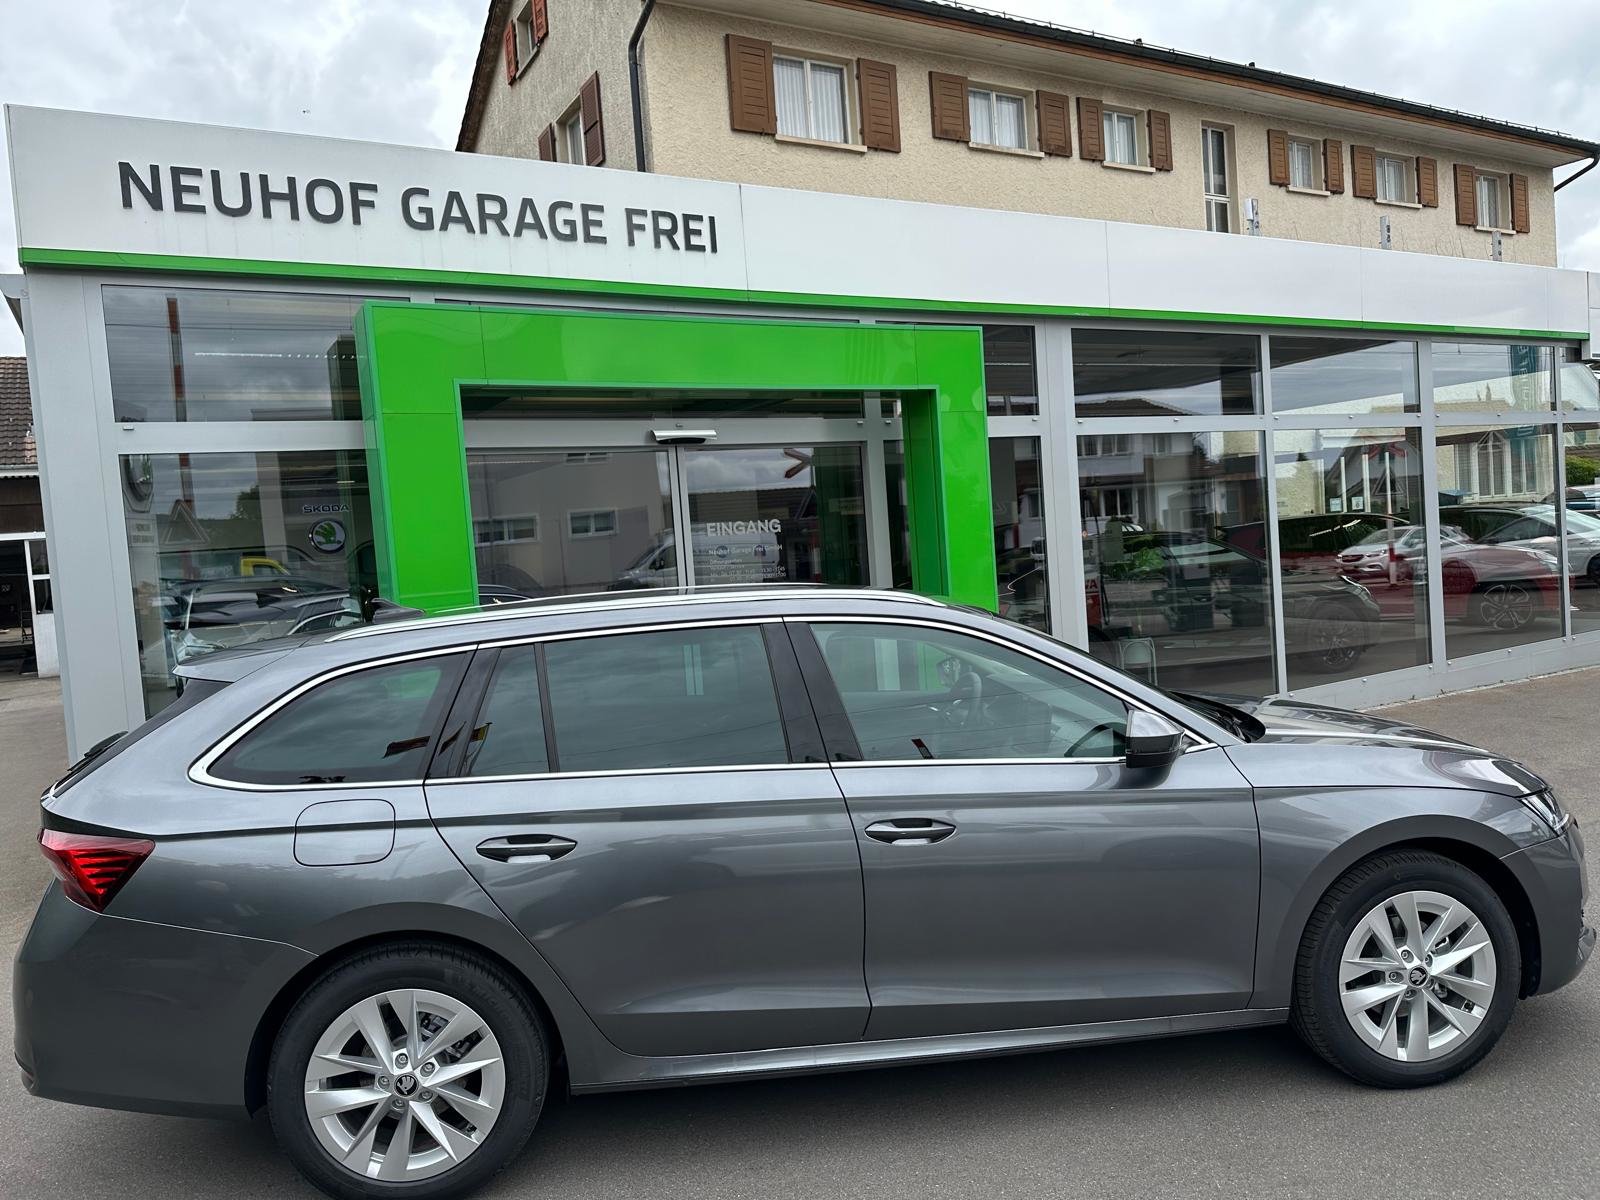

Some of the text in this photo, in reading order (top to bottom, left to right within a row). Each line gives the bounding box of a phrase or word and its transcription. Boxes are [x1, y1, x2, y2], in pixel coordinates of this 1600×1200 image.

[118, 161, 718, 253] NEUHOF GARAGE FREI
[706, 519, 781, 536] EINGANG
